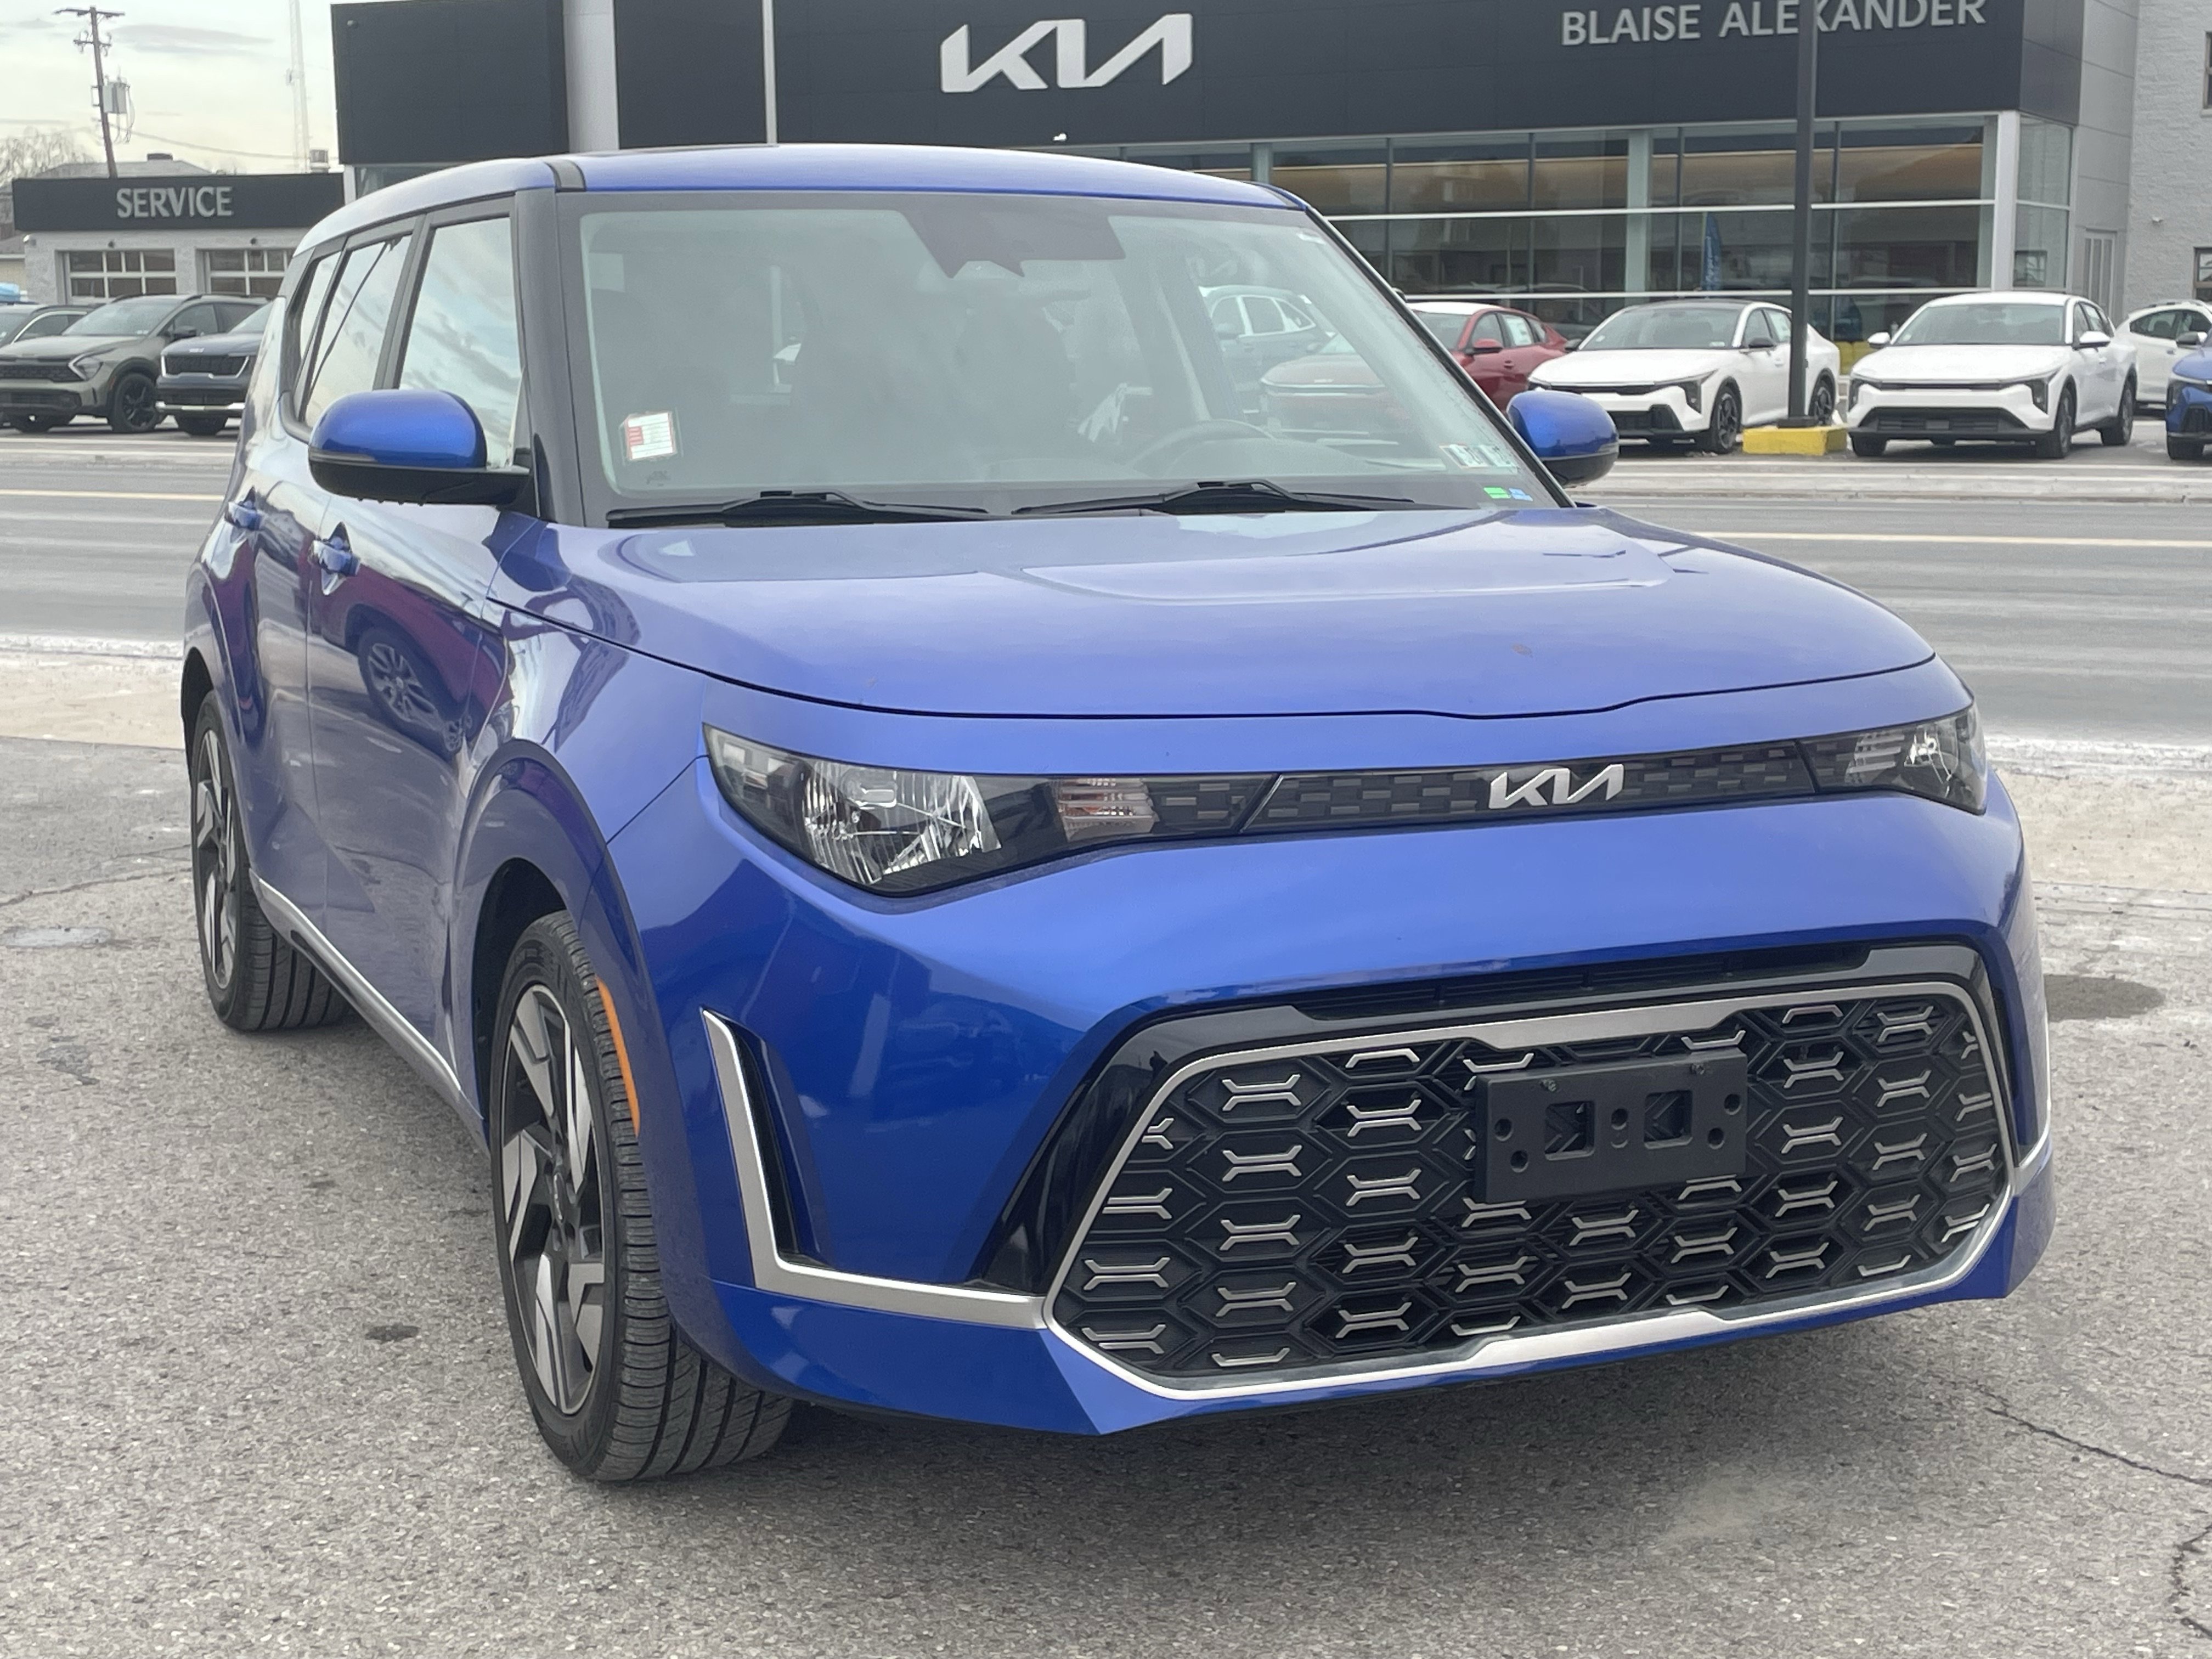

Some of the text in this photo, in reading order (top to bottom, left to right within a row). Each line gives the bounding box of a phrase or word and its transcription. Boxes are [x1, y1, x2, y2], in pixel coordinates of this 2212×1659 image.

[1562, 4, 1701, 46] BLAISE
[116, 186, 233, 218] SERVICE
[1488, 764, 1624, 809] KIA
